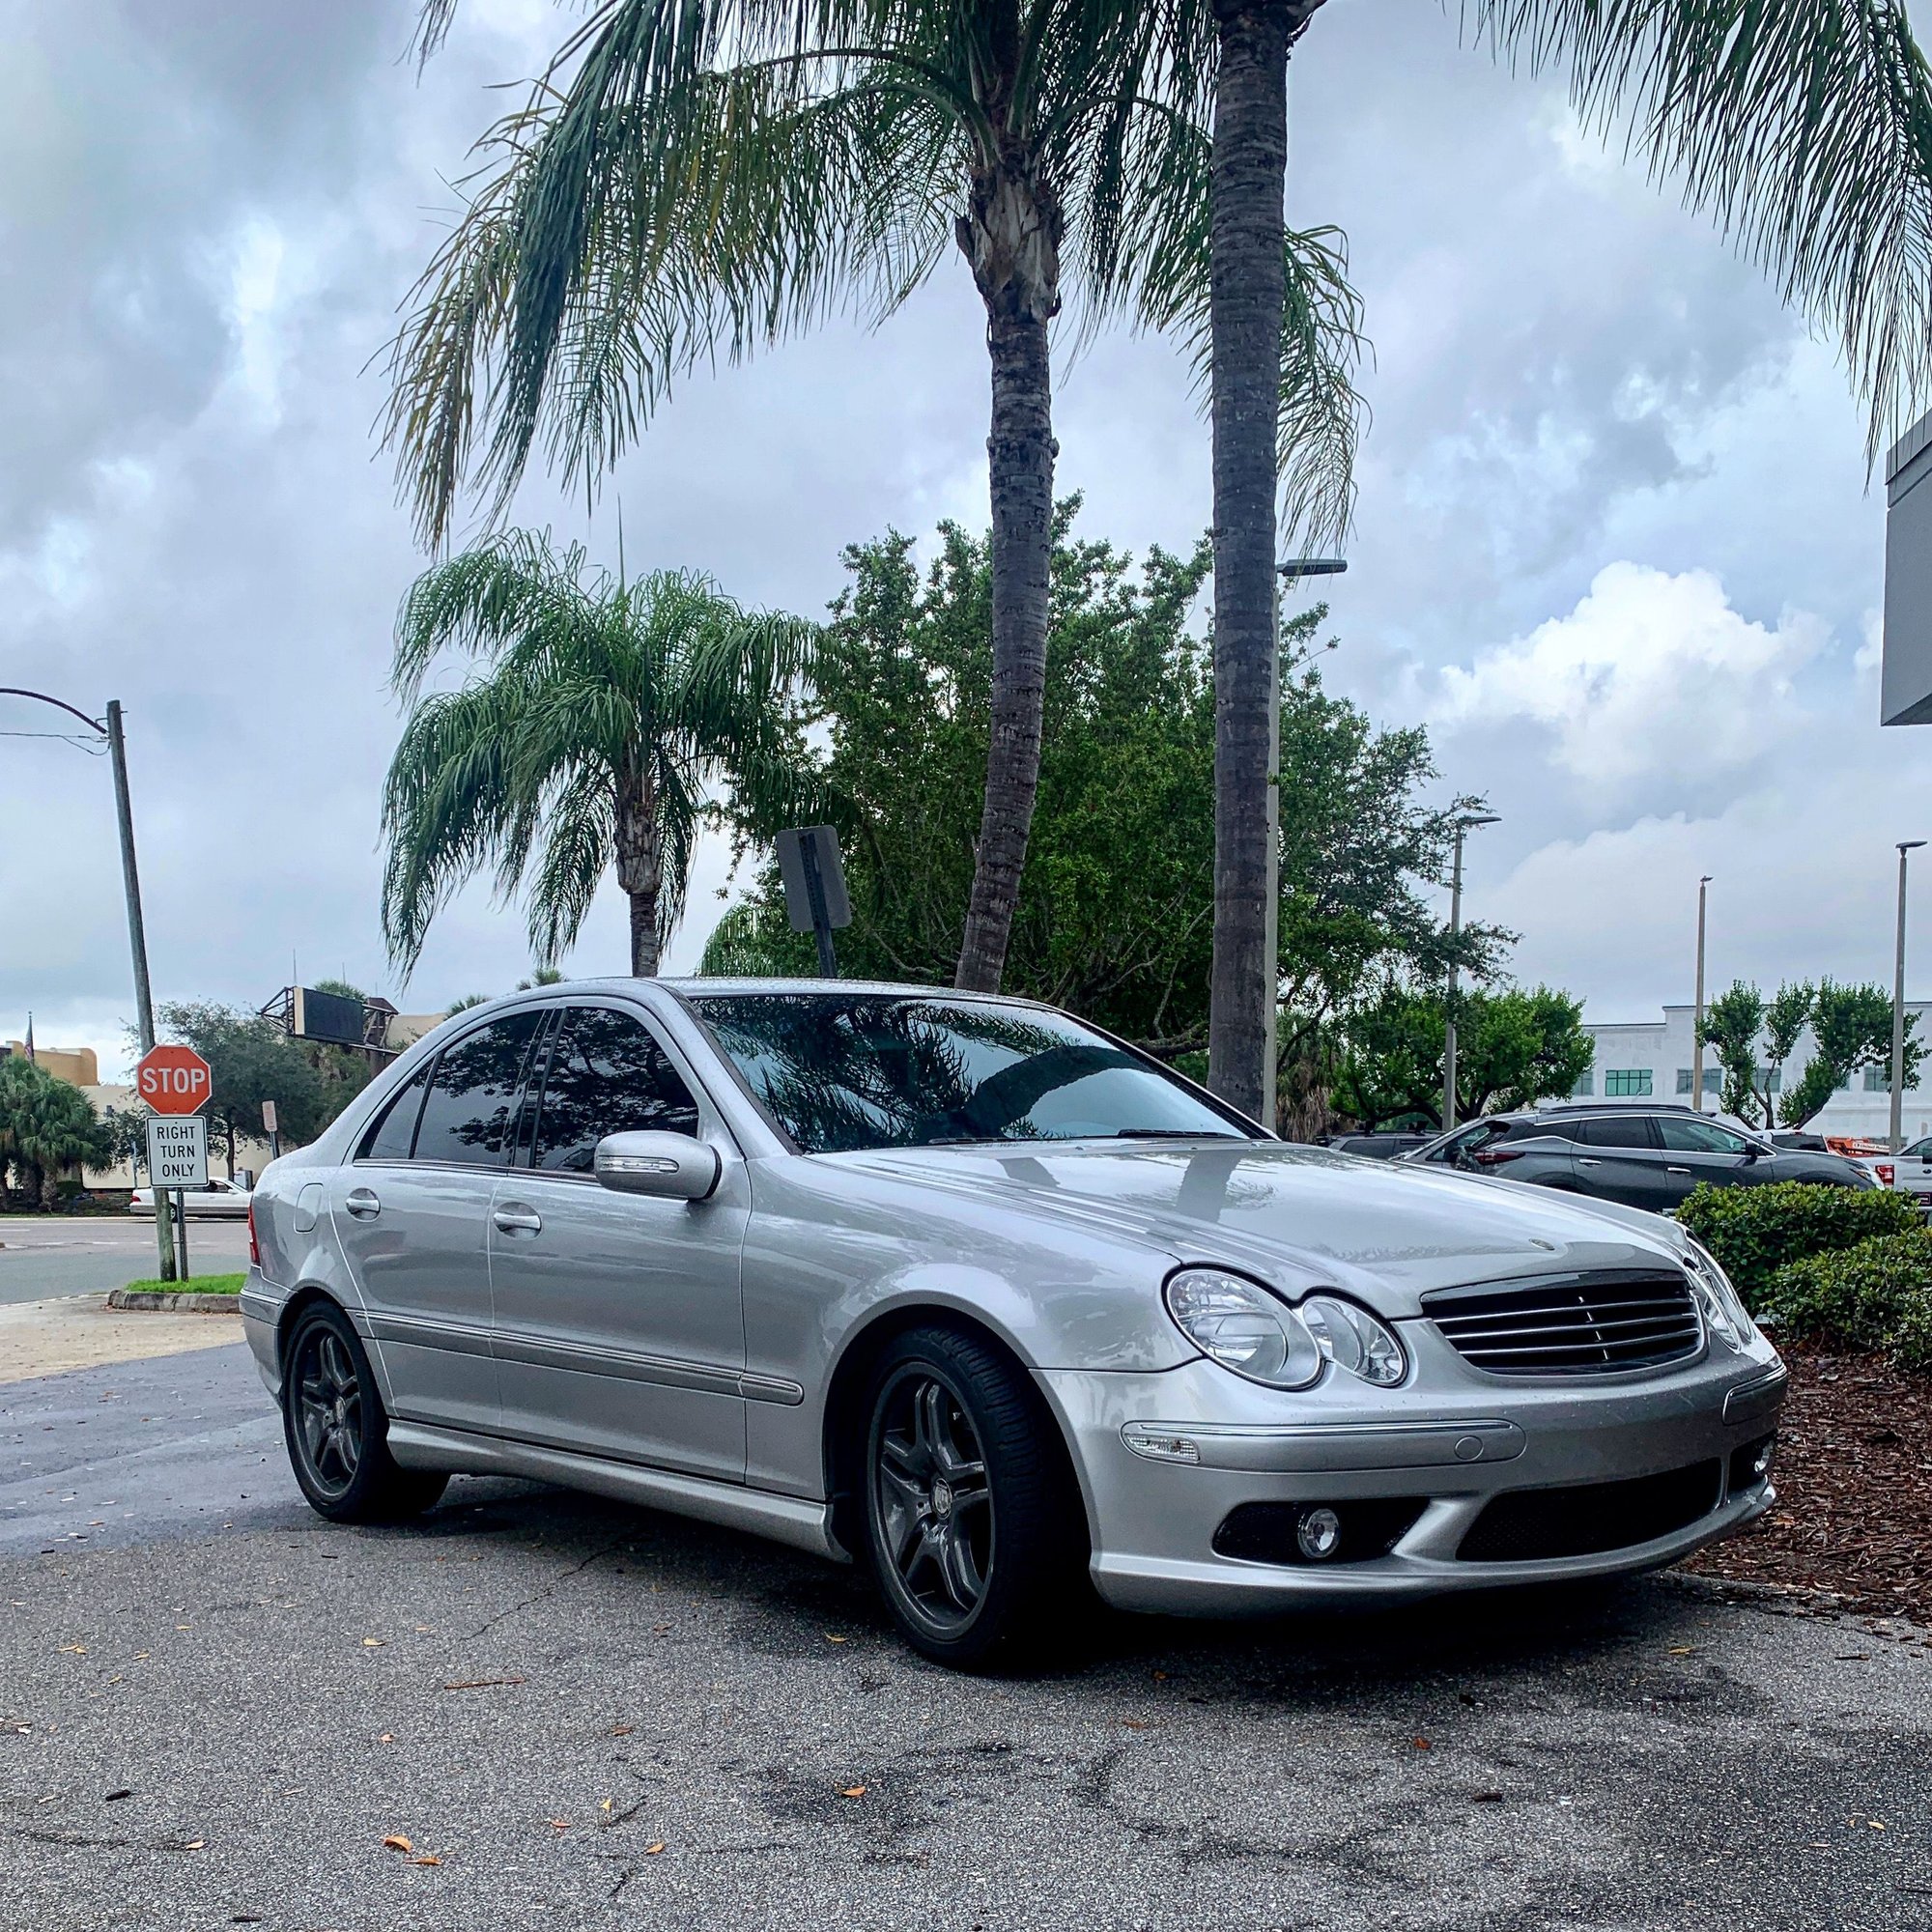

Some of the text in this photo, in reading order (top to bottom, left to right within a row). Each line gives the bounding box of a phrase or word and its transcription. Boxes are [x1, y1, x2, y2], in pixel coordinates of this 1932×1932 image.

[142, 1067, 206, 1094] STOP
[156, 1126, 195, 1140] RIGHT
[160, 1145, 195, 1158] TURN
[162, 1164, 194, 1177] ONLY
